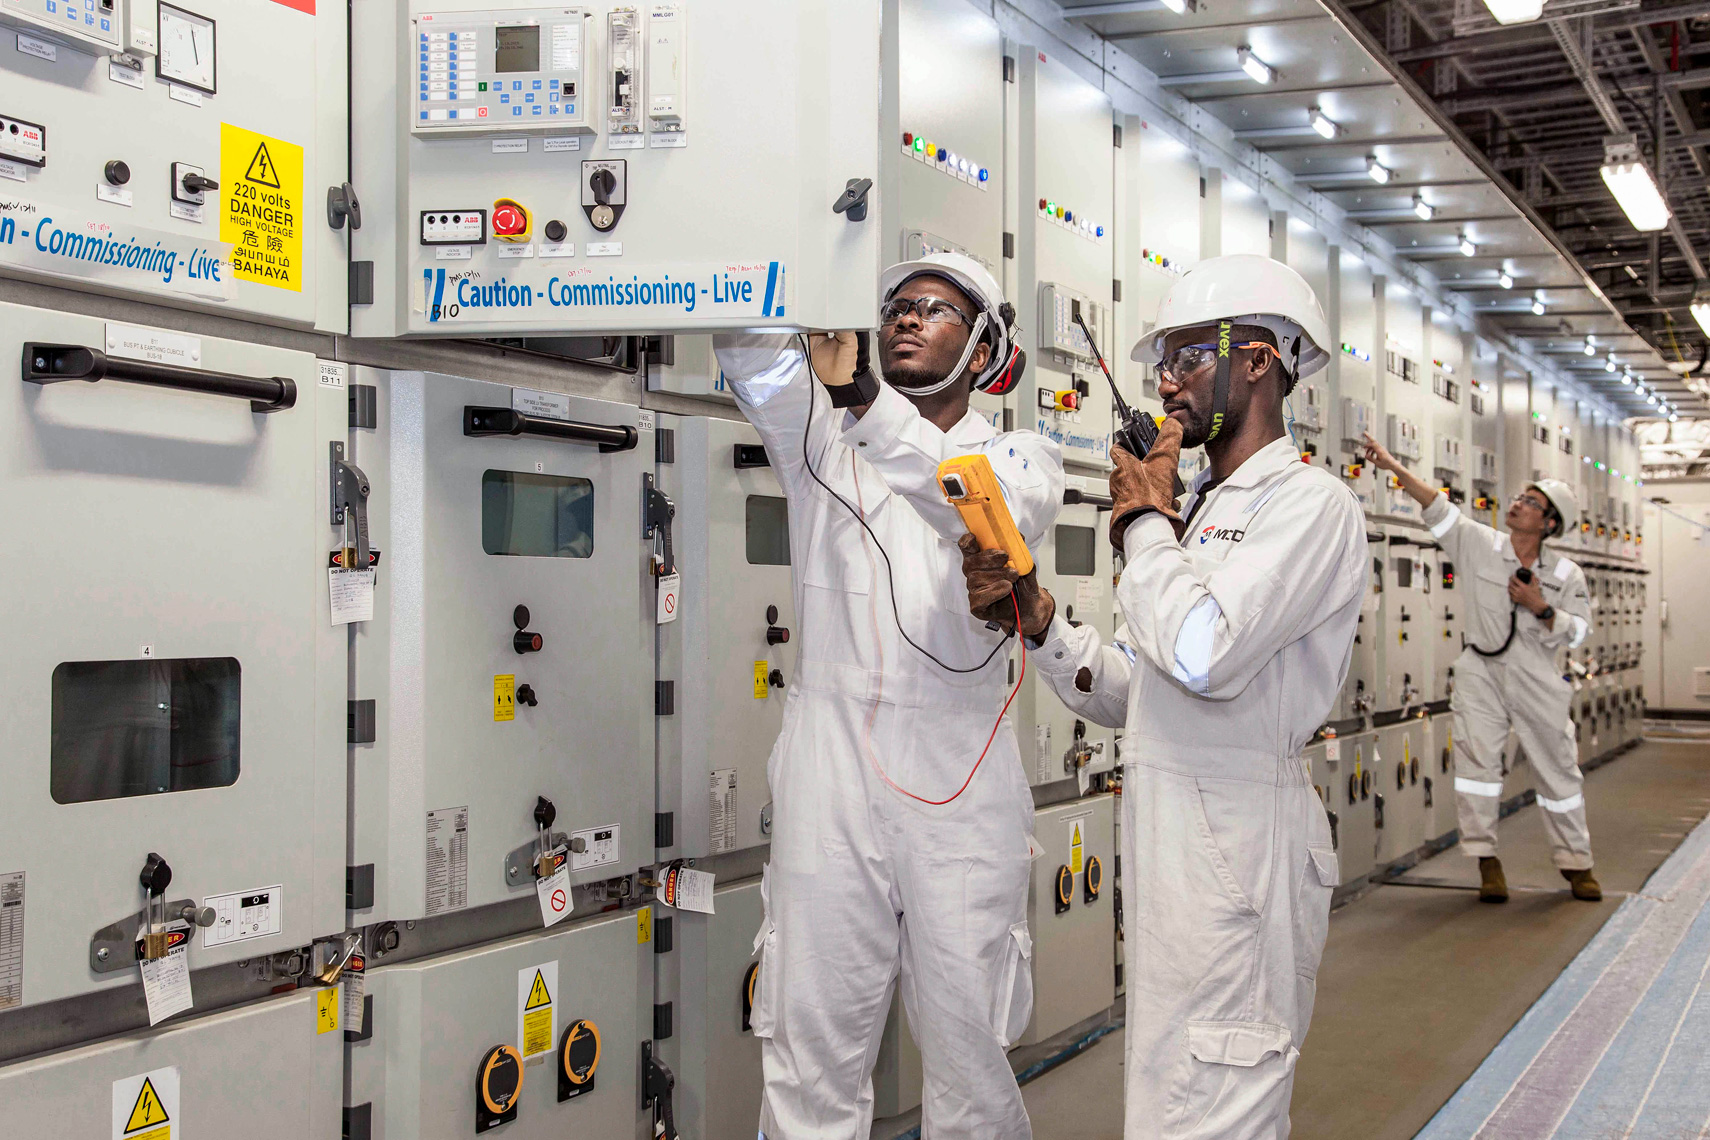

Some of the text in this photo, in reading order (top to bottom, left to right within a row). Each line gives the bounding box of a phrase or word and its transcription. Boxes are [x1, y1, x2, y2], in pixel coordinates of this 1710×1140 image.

[23, 130, 38, 140] ABB
[234, 182, 290, 209] 220 volts
[231, 198, 293, 227] DANGER
[230, 215, 293, 238] HIGH VOLTAGE
[36, 217, 177, 283] Commissioning
[188, 248, 220, 282] Live
[242, 229, 283, 253] 危險
[234, 259, 289, 282] BAHAYA
[458, 278, 532, 307] Caution
[549, 275, 695, 312] Commissioning
[714, 273, 752, 302] Live
[432, 304, 459, 319] B10
[144, 345, 166, 353] EARTHING
[322, 376, 340, 384] B11
[144, 647, 149, 656] 4
